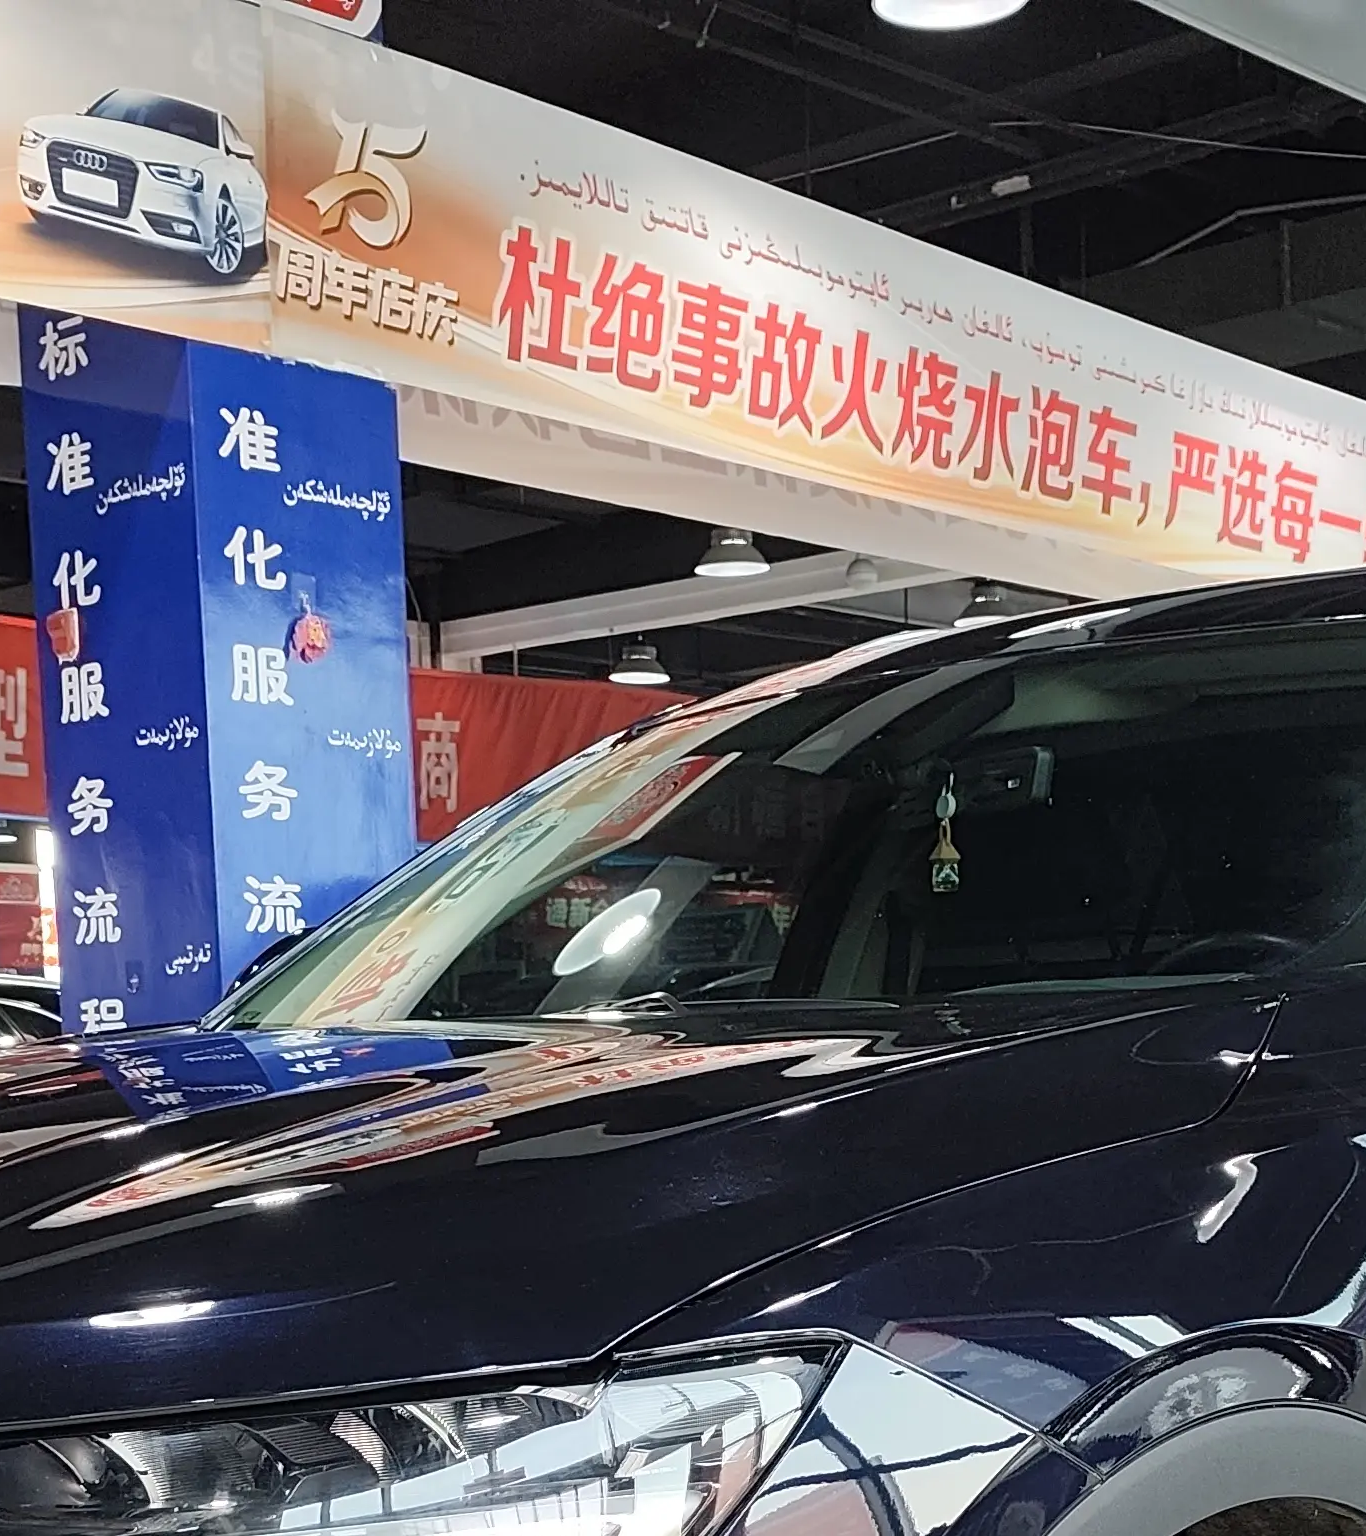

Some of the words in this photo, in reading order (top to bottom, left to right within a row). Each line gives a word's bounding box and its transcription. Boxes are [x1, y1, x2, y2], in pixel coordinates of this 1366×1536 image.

[269, 240, 461, 345] 周年店庆
[417, 711, 459, 816] 商
